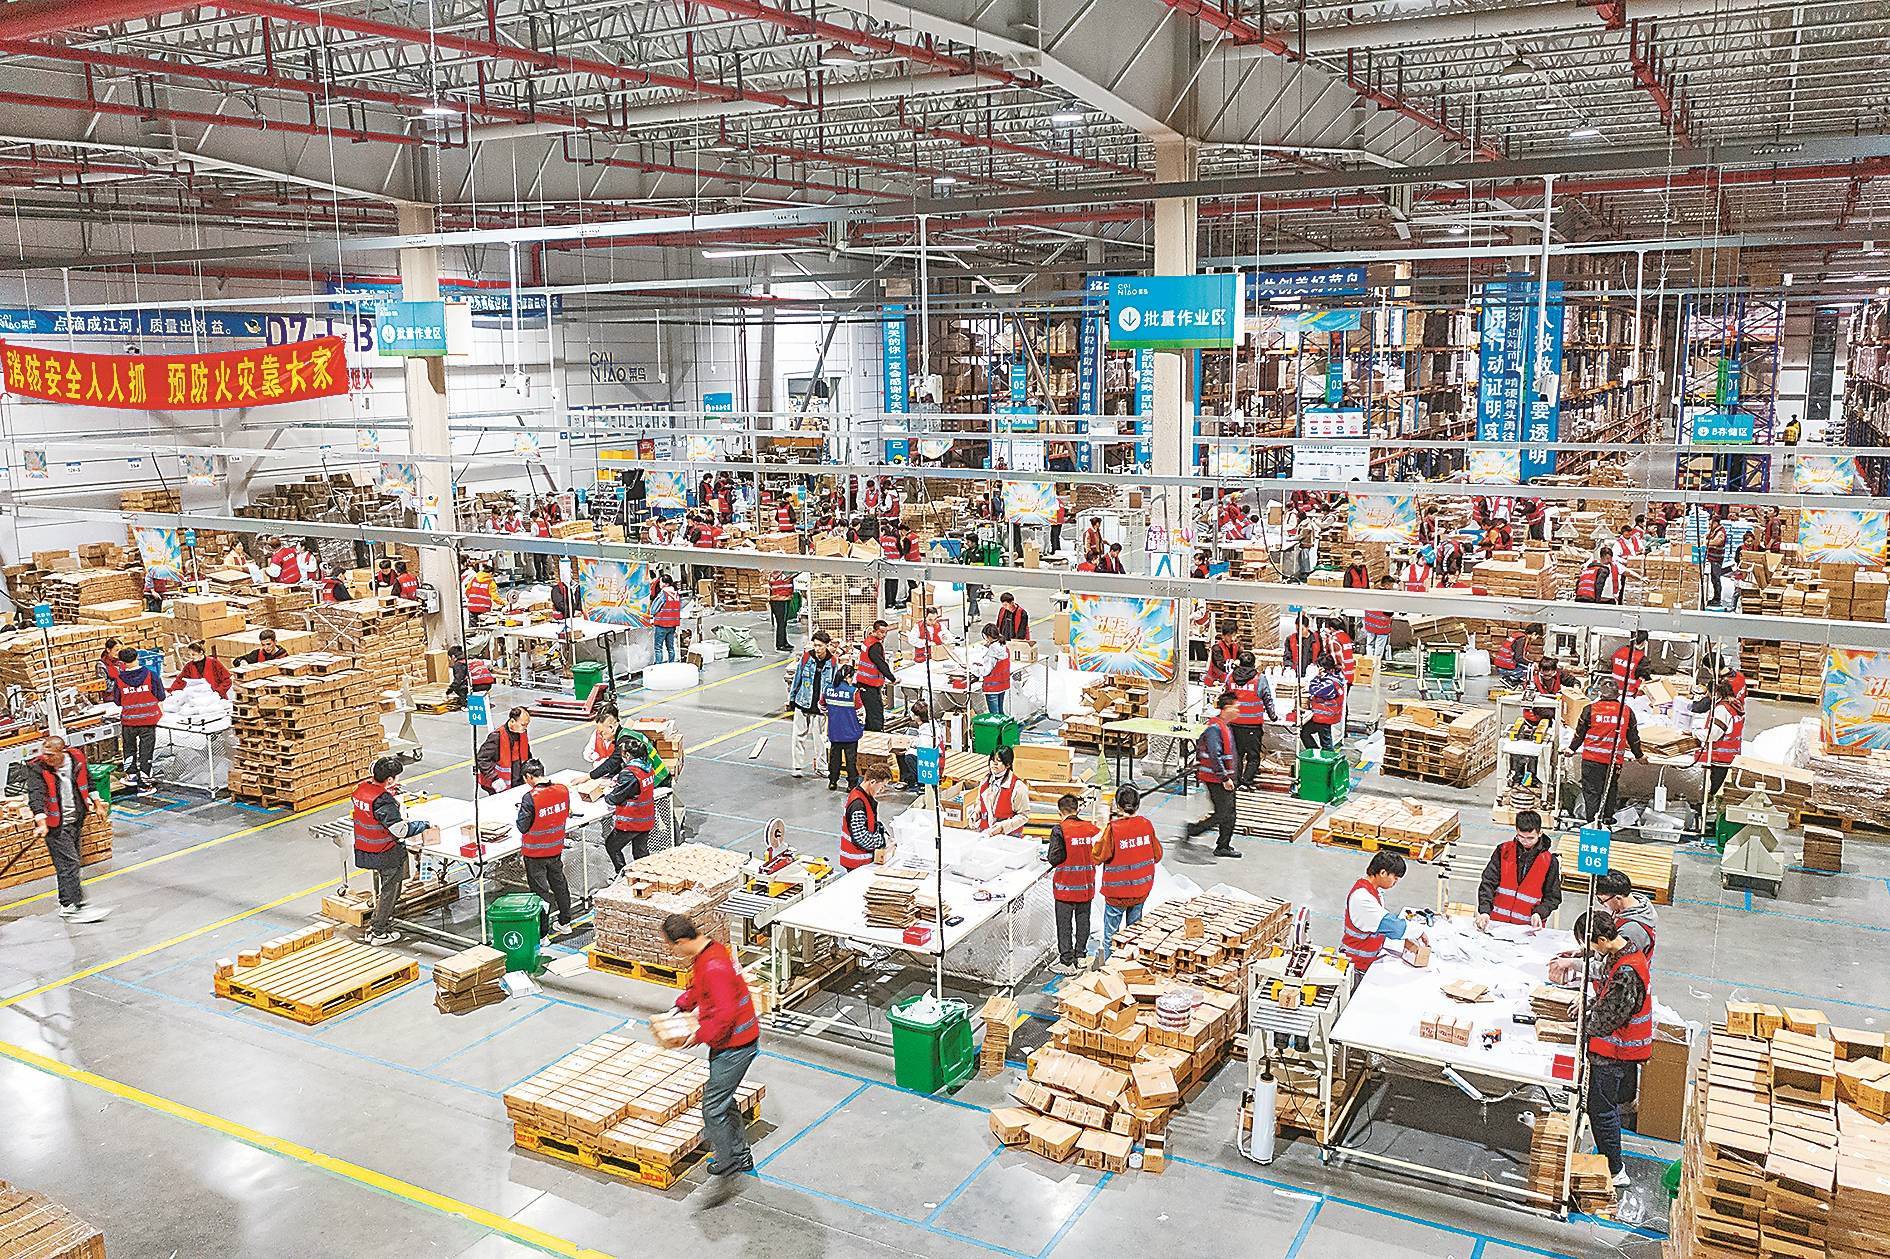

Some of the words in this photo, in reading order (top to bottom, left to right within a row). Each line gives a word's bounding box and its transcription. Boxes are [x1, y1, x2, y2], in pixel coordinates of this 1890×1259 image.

[1144, 308, 1227, 327] 批量作业区
[590, 352, 613, 366] CAI
[7, 349, 147, 404] 消防安全人人抓
[168, 345, 333, 405] 预防火灾靠大家
[347, 367, 374, 390] 烟火
[887, 321, 903, 449] 明天的你一定会感谢今天己
[1013, 380, 1026, 390] 05
[1331, 380, 1342, 390] 03
[1595, 714, 1625, 725] 浙江
[921, 769, 933, 778] 05
[1584, 856, 1602, 868] 06
